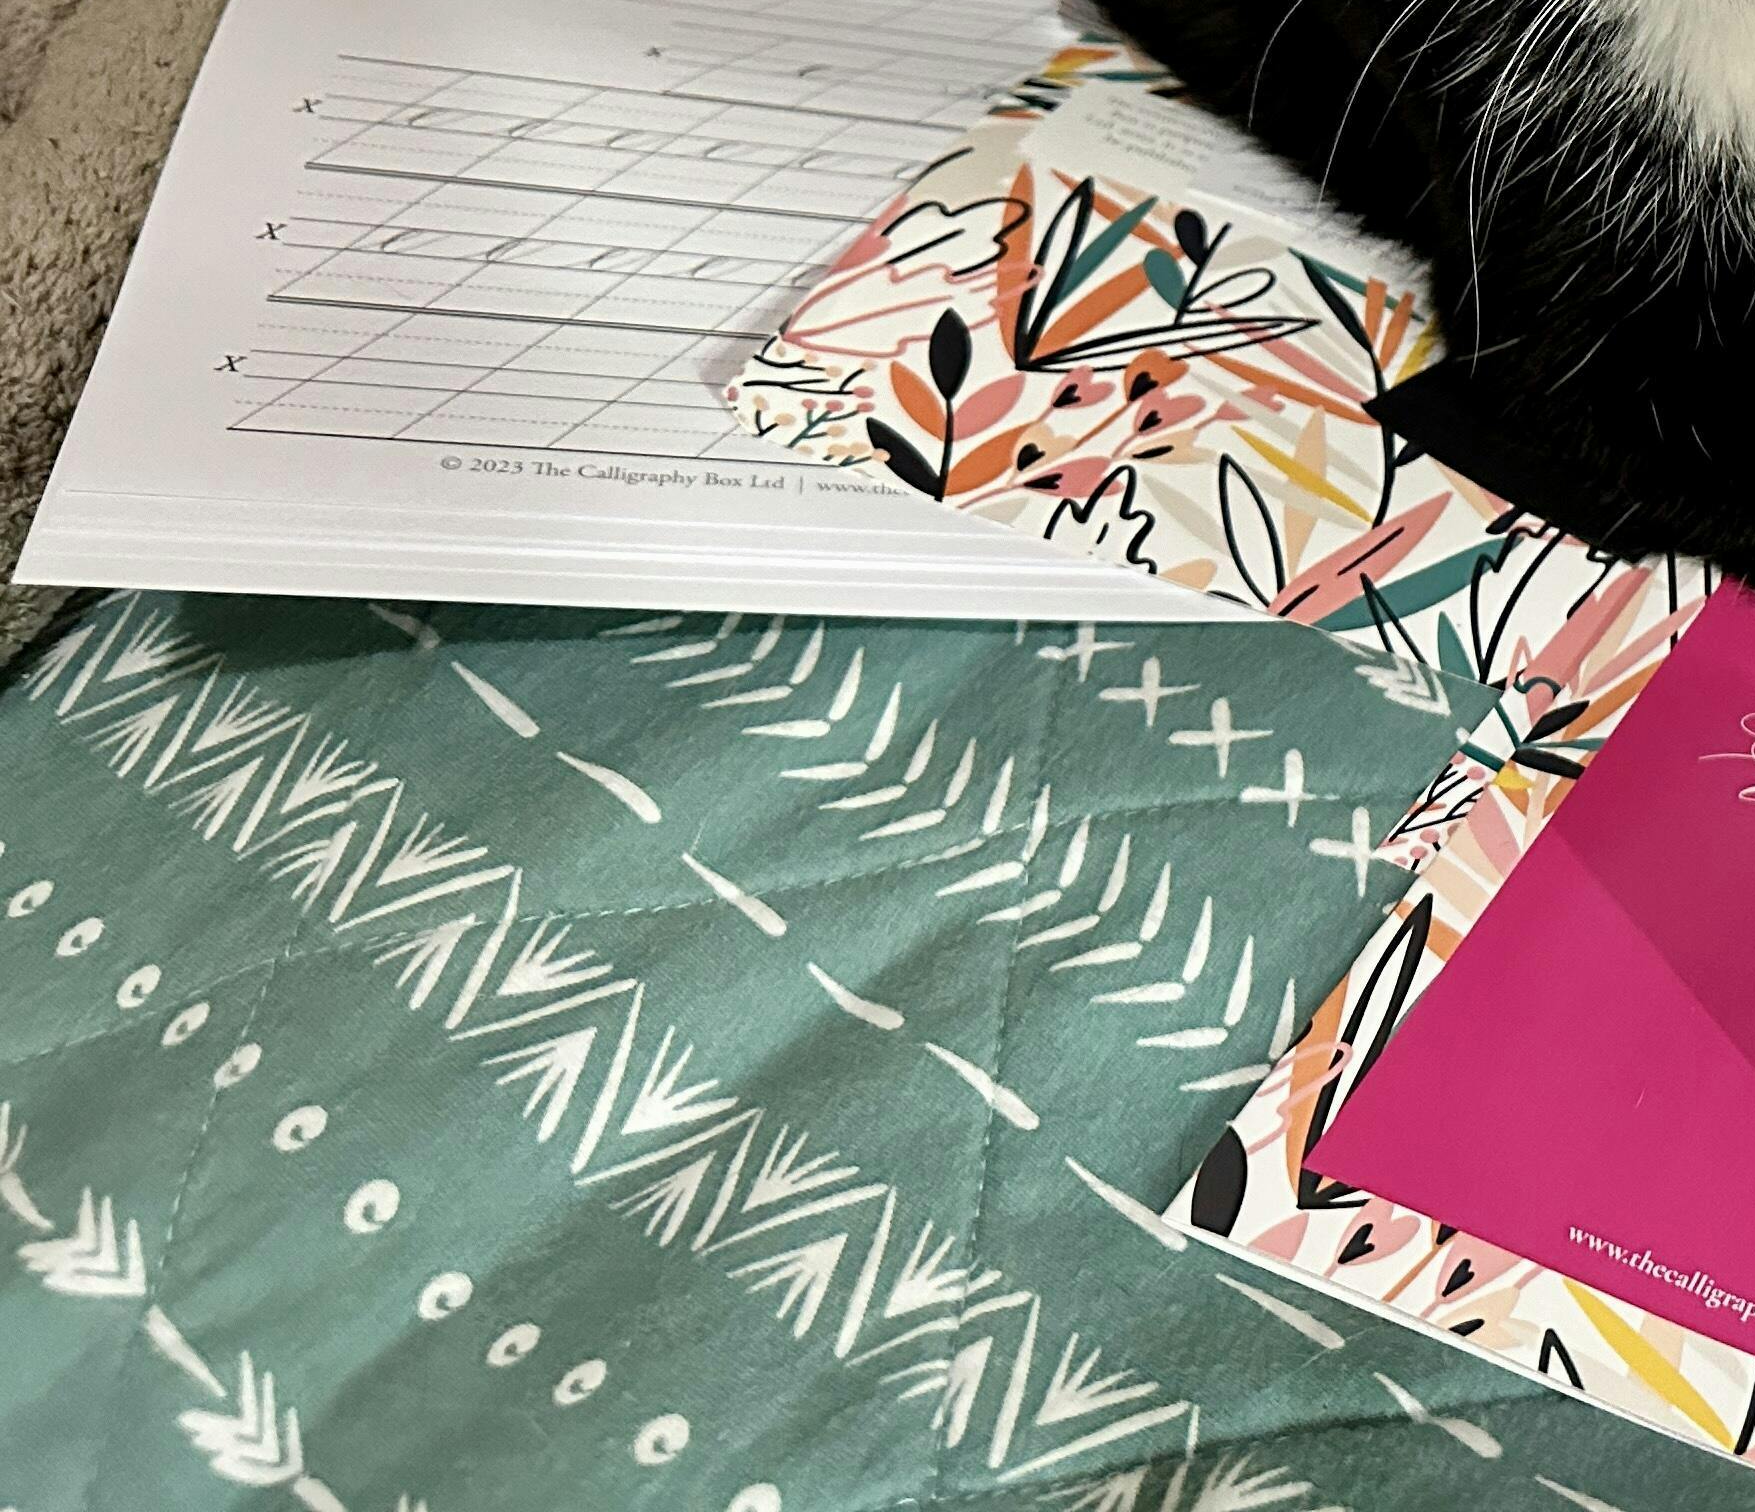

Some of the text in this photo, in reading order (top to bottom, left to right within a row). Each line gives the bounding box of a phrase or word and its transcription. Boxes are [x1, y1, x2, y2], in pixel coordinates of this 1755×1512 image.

[469, 457, 525, 476] 2023
[531, 460, 571, 479] The
[577, 463, 698, 490] Calligraphy
[704, 471, 743, 490] Box
[749, 474, 786, 491] Ltd
